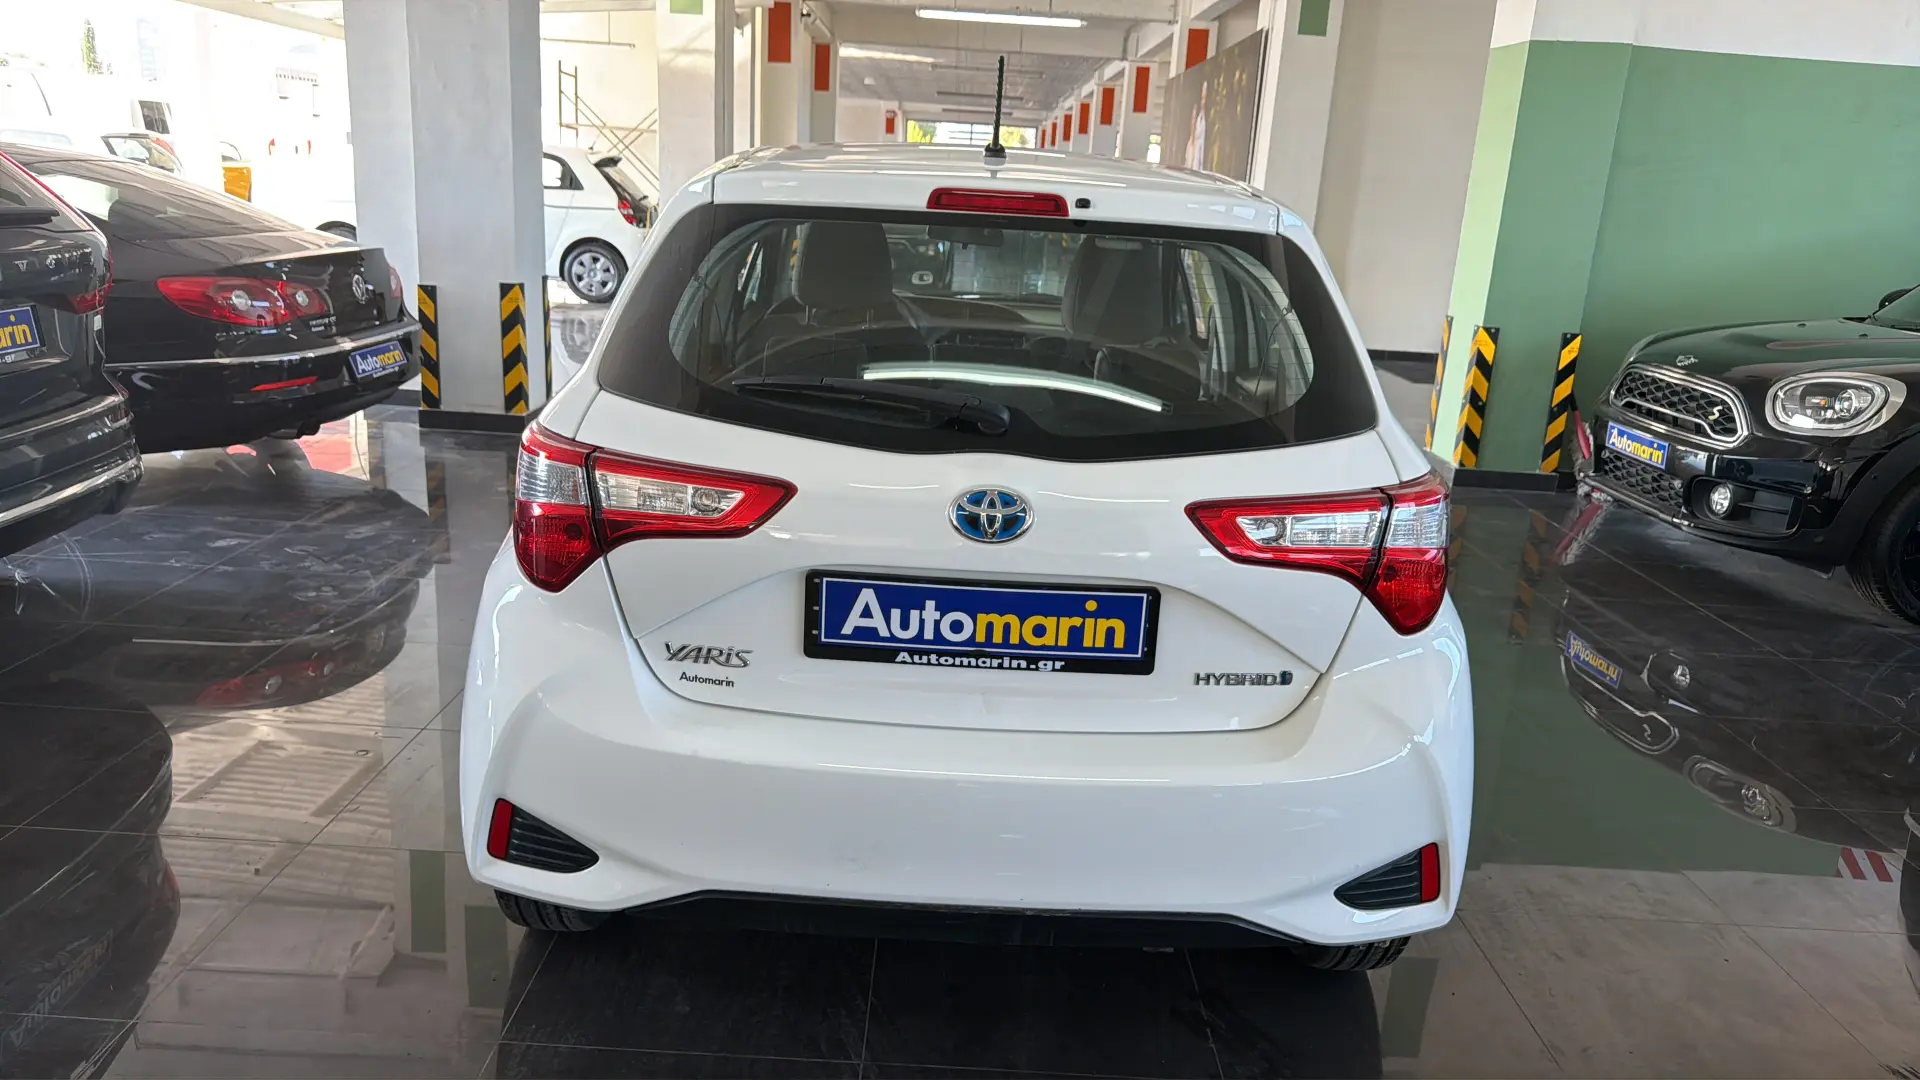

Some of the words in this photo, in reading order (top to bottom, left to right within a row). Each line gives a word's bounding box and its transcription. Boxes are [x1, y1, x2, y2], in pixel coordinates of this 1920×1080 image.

[356, 345, 403, 373] Automarin
[1609, 427, 1664, 464] Automarin
[840, 588, 1126, 648] Automarin
[895, 652, 1065, 671] Automarin.gr
[679, 672, 734, 688] Automarin
[1194, 672, 1277, 686] HYBRID
